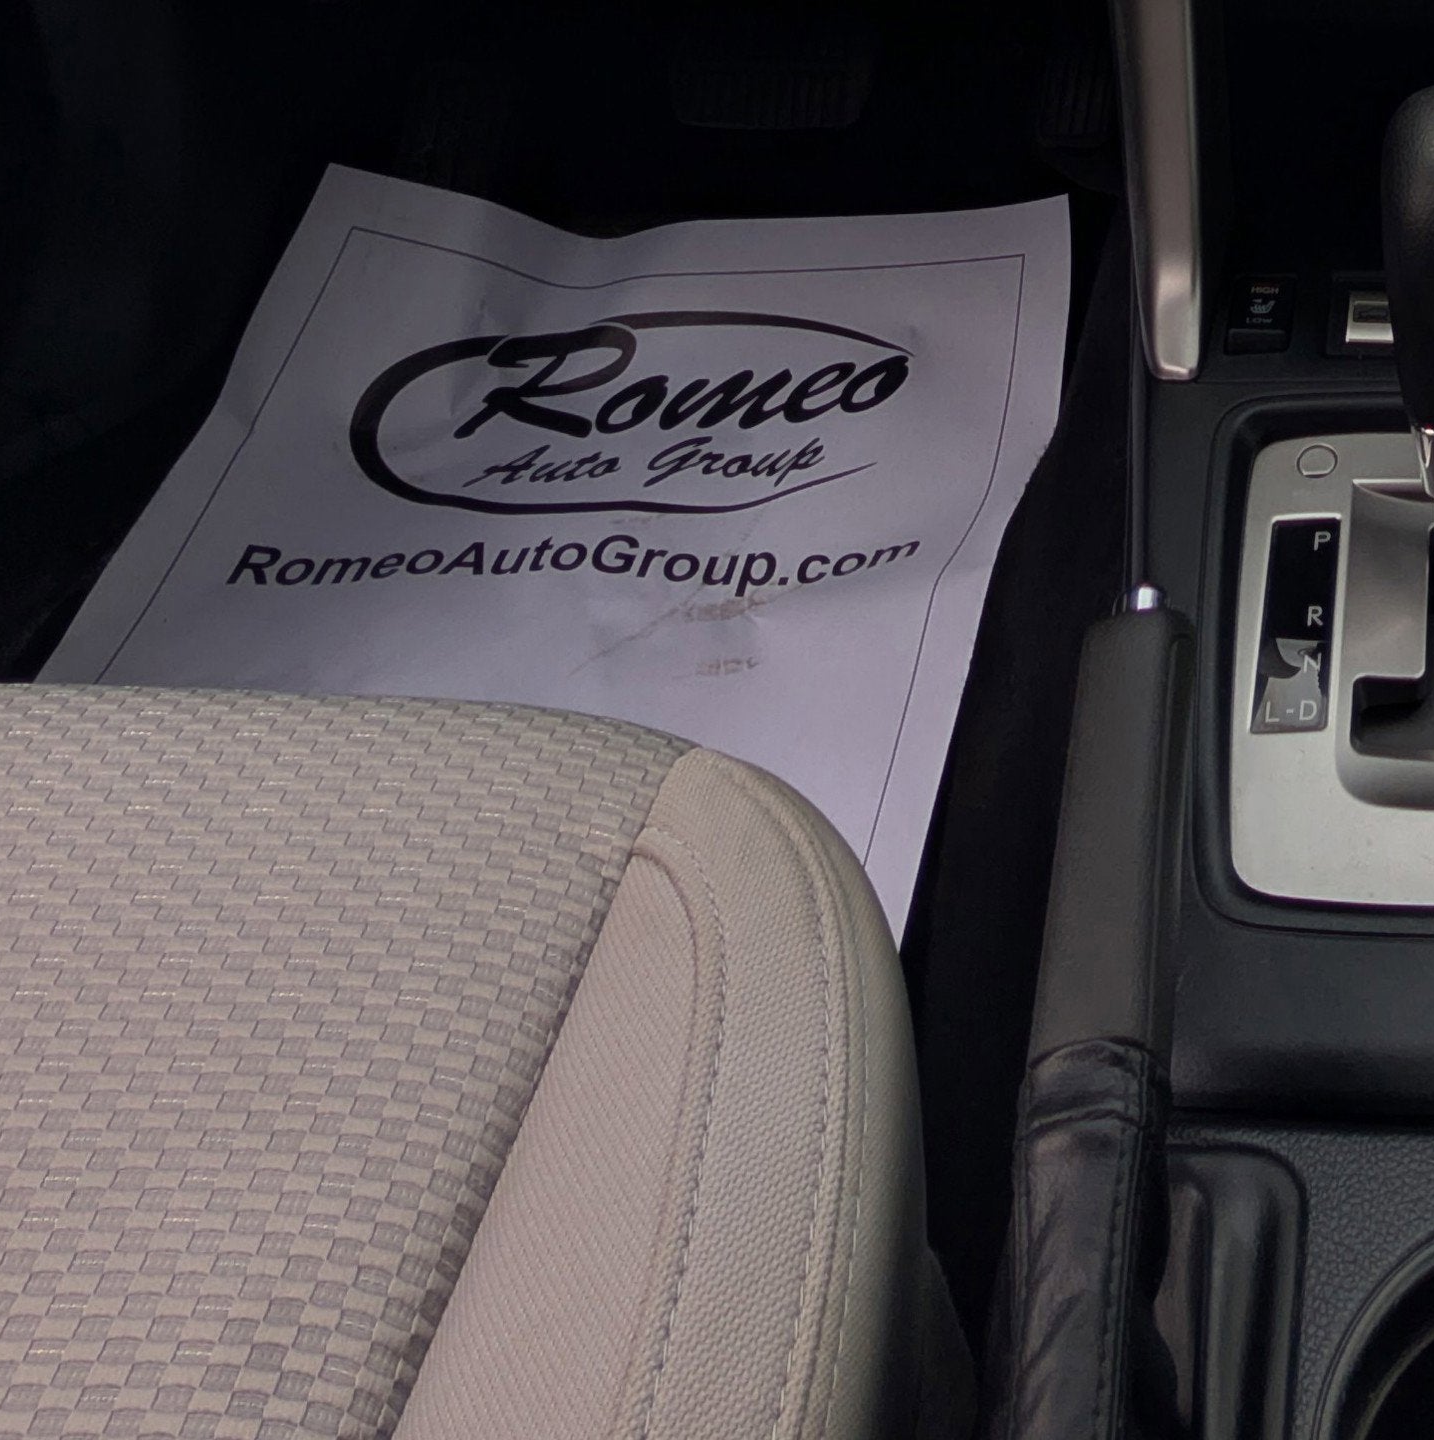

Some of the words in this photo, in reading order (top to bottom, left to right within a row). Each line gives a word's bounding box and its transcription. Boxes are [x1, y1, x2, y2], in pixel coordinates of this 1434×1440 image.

[454, 323, 910, 439] Romeo
[464, 445, 621, 487] Auto
[643, 436, 825, 488] Group
[1313, 531, 1331, 551] P
[225, 534, 921, 596] RomeoAutoGroup.com
[1306, 605, 1323, 626] R
[1303, 654, 1322, 673] N
